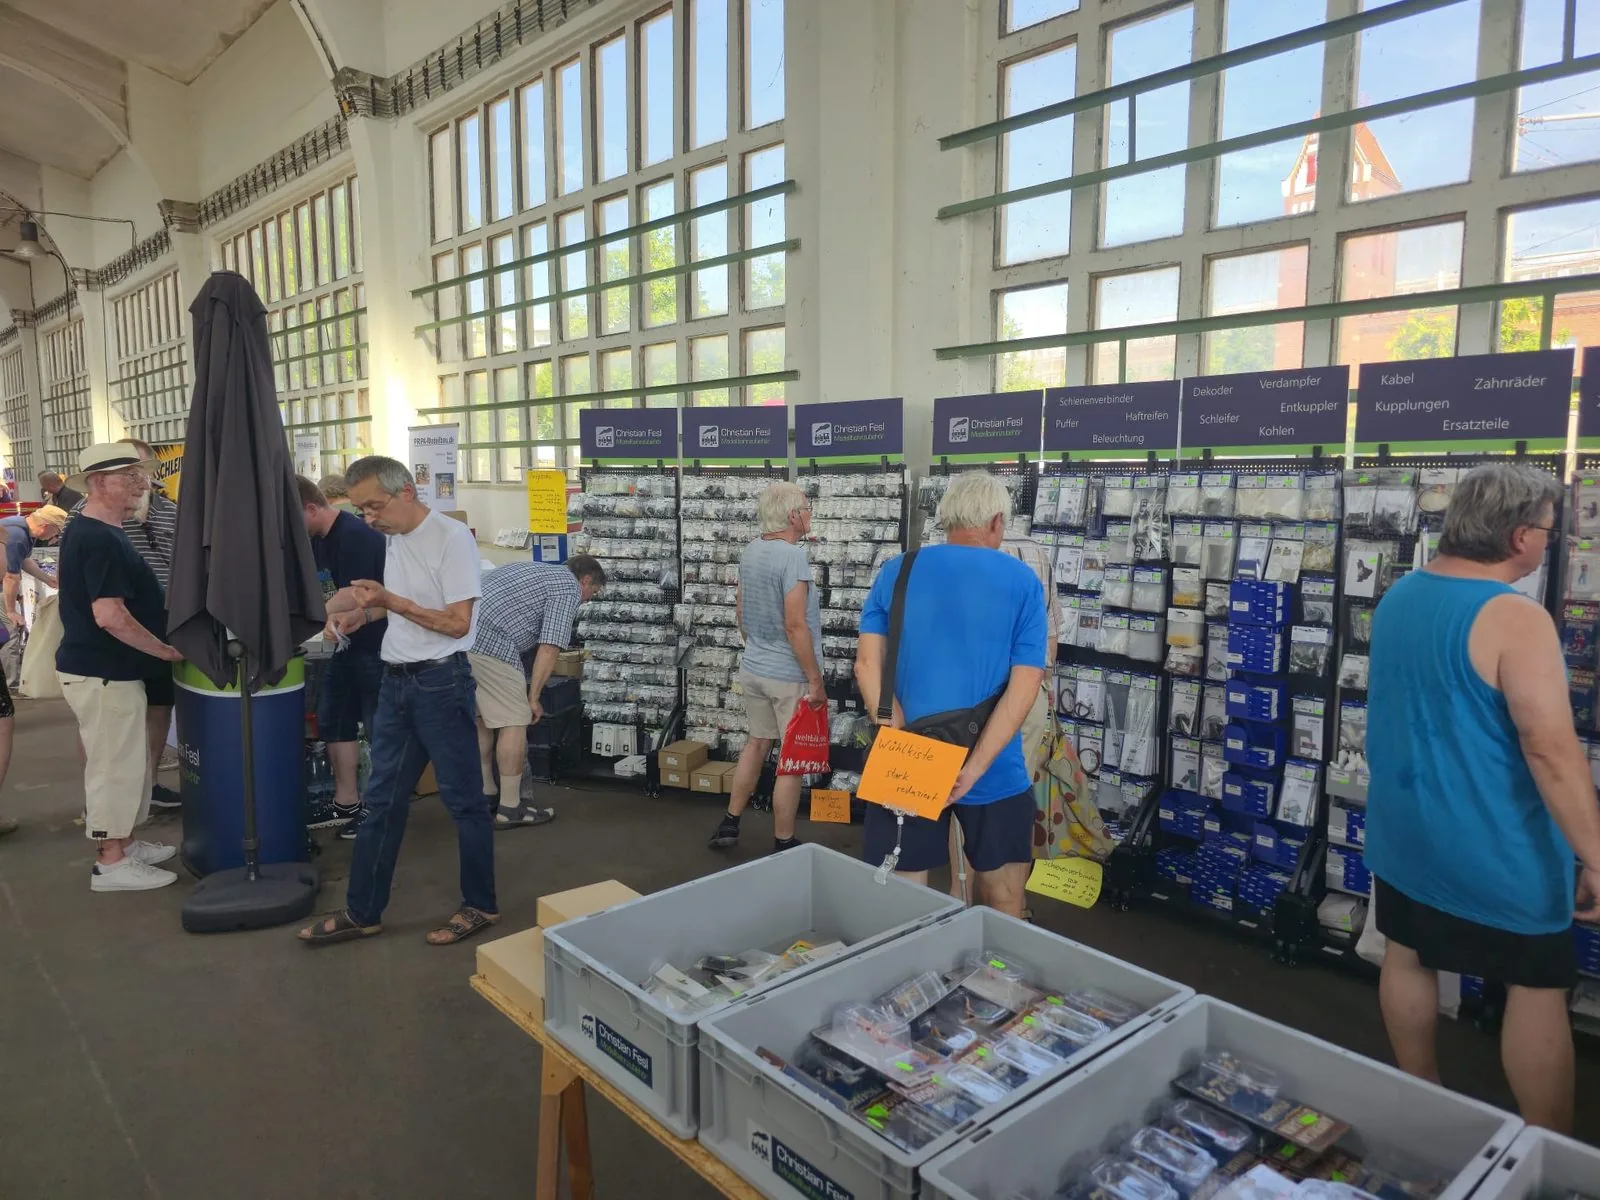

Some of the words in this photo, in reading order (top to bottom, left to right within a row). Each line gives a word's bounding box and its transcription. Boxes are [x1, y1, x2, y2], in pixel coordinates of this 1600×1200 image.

[1259, 375, 1321, 390] Verdampfer
[1381, 373, 1414, 385] Kabel
[1474, 374, 1547, 390] Zahnräder
[1193, 385, 1234, 397] Dekoder
[1059, 393, 1134, 406] Schienenverbinder
[1280, 400, 1338, 413] Entkuppler
[1375, 399, 1450, 414] Kupplungen
[1125, 411, 1169, 421] Haftreifen
[1199, 412, 1240, 425] Schleifer
[833, 424, 867, 434] Christian
[869, 422, 885, 431] Fesl
[970, 419, 1005, 429] Christian
[1055, 418, 1079, 429] Puffer
[1443, 417, 1510, 431] Ersatzteile
[615, 428, 646, 437] Christian
[647, 428, 662, 437] Fesl
[720, 428, 753, 437] Christian
[755, 427, 770, 436] Fesl
[1259, 426, 1295, 437] Kohlen
[1092, 433, 1145, 444] Beleuchtung
[878, 738, 935, 761] Wühlkiste
[884, 767, 910, 781] stark
[896, 783, 939, 801] reduziert
[598, 1022, 633, 1057] Christian
[632, 1048, 649, 1071] Fesl
[775, 1144, 825, 1190] Christian
